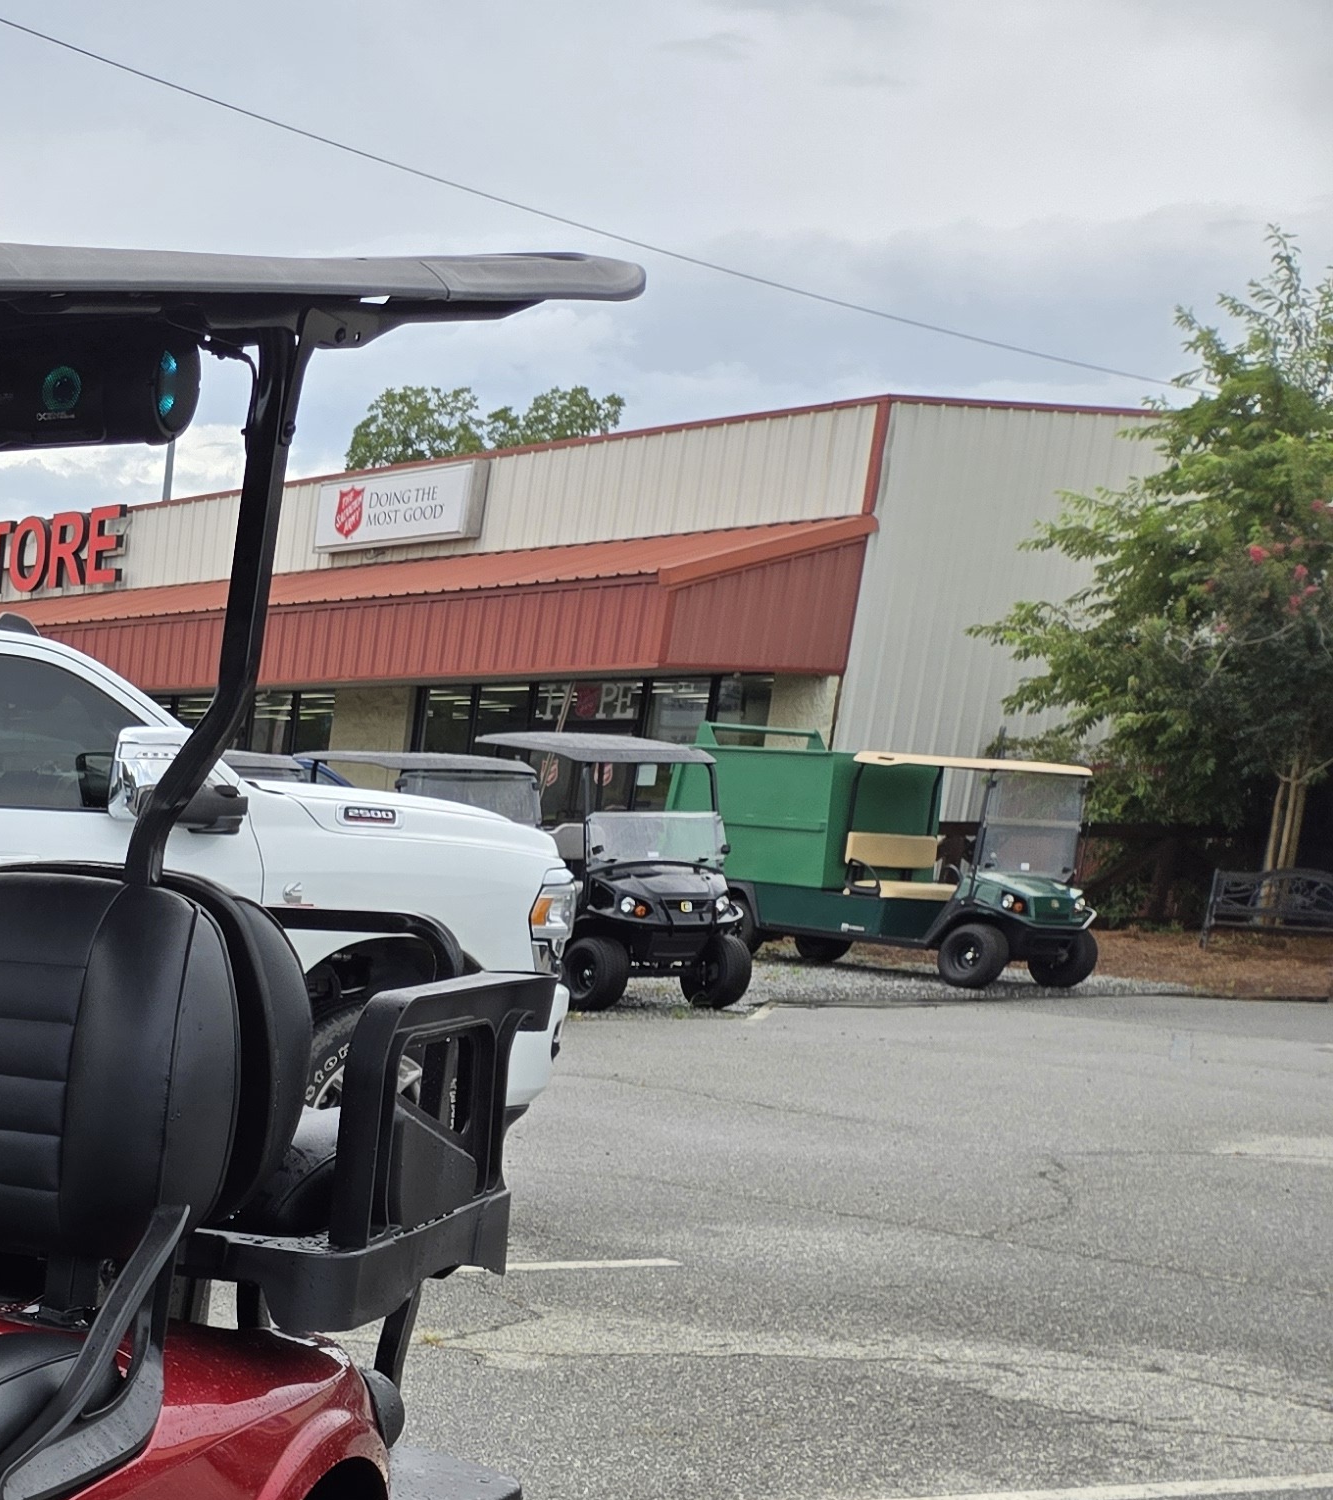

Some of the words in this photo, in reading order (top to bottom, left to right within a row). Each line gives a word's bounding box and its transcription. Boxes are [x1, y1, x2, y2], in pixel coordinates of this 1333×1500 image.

[368, 489, 412, 509] DOING
[414, 485, 439, 502] THE
[366, 509, 400, 527] MOST
[403, 504, 444, 523] GOOD
[348, 808, 393, 819] 2500
